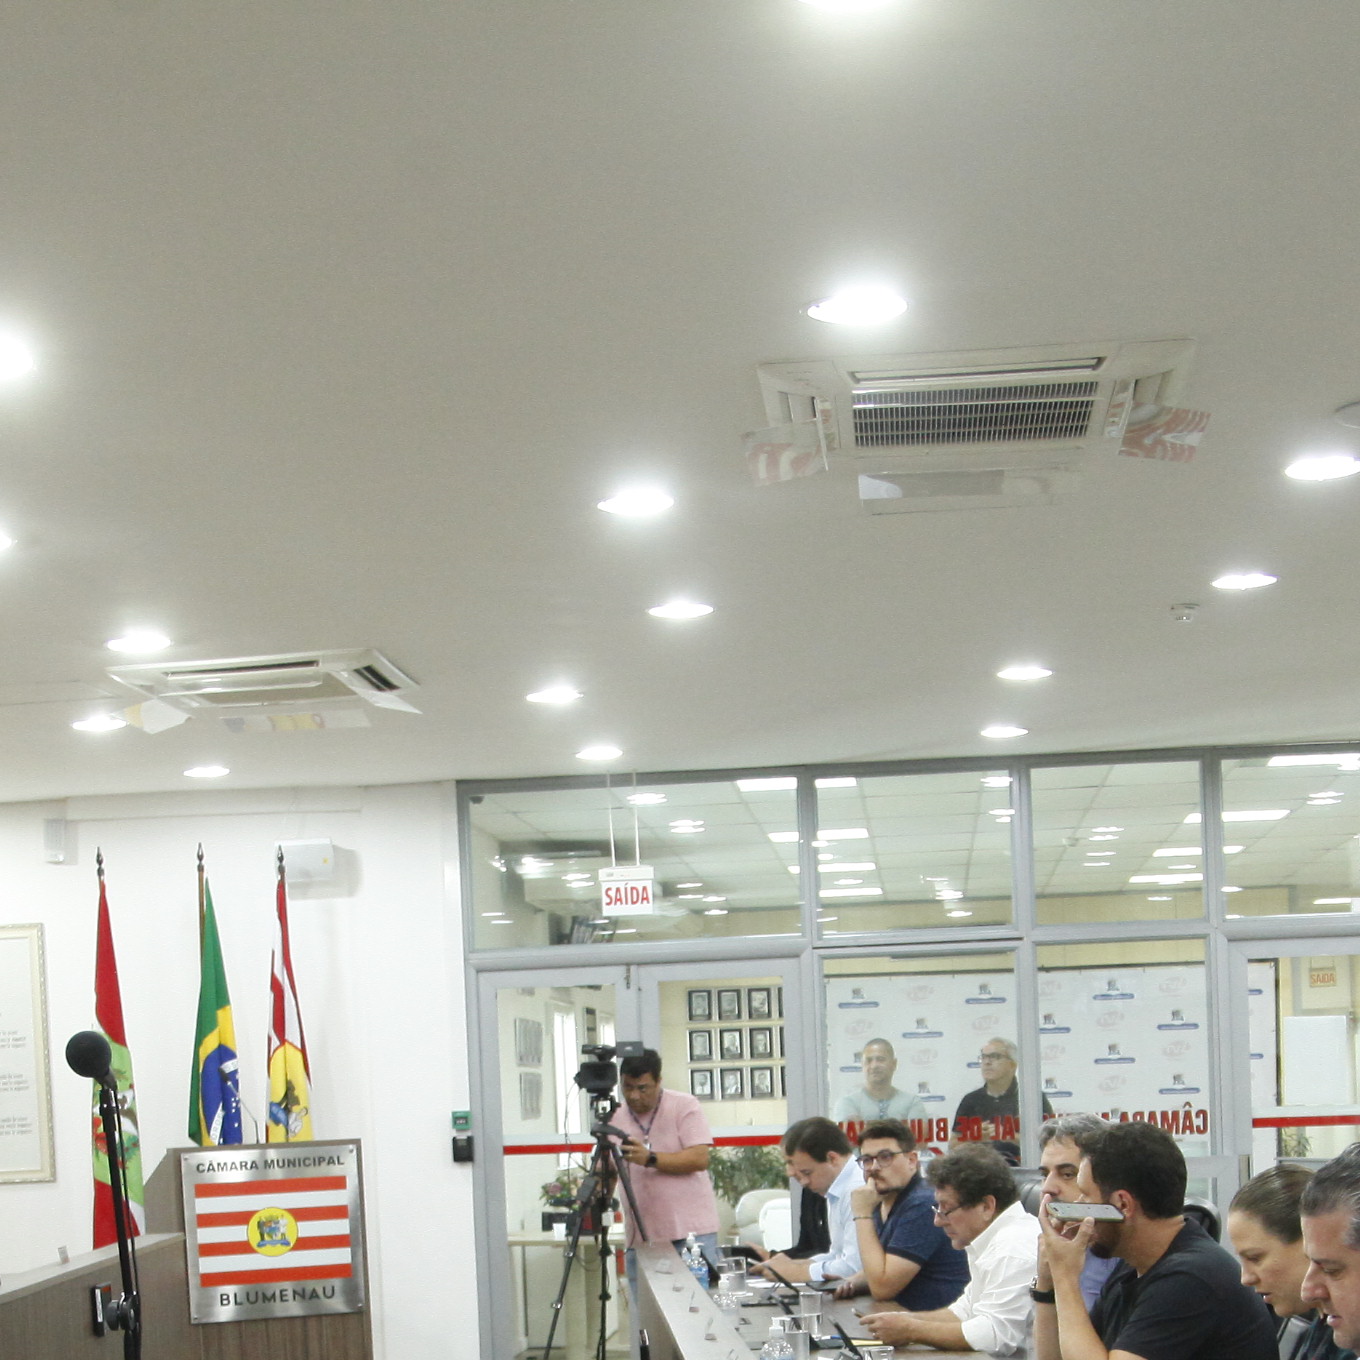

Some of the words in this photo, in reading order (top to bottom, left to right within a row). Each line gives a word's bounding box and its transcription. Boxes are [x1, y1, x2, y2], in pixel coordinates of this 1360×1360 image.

[605, 882, 650, 906] SAÍDA
[196, 1160, 259, 1174] CÂMARA
[263, 1155, 345, 1170] MUNICIPAL
[219, 1286, 336, 1307] BLUMENAU
